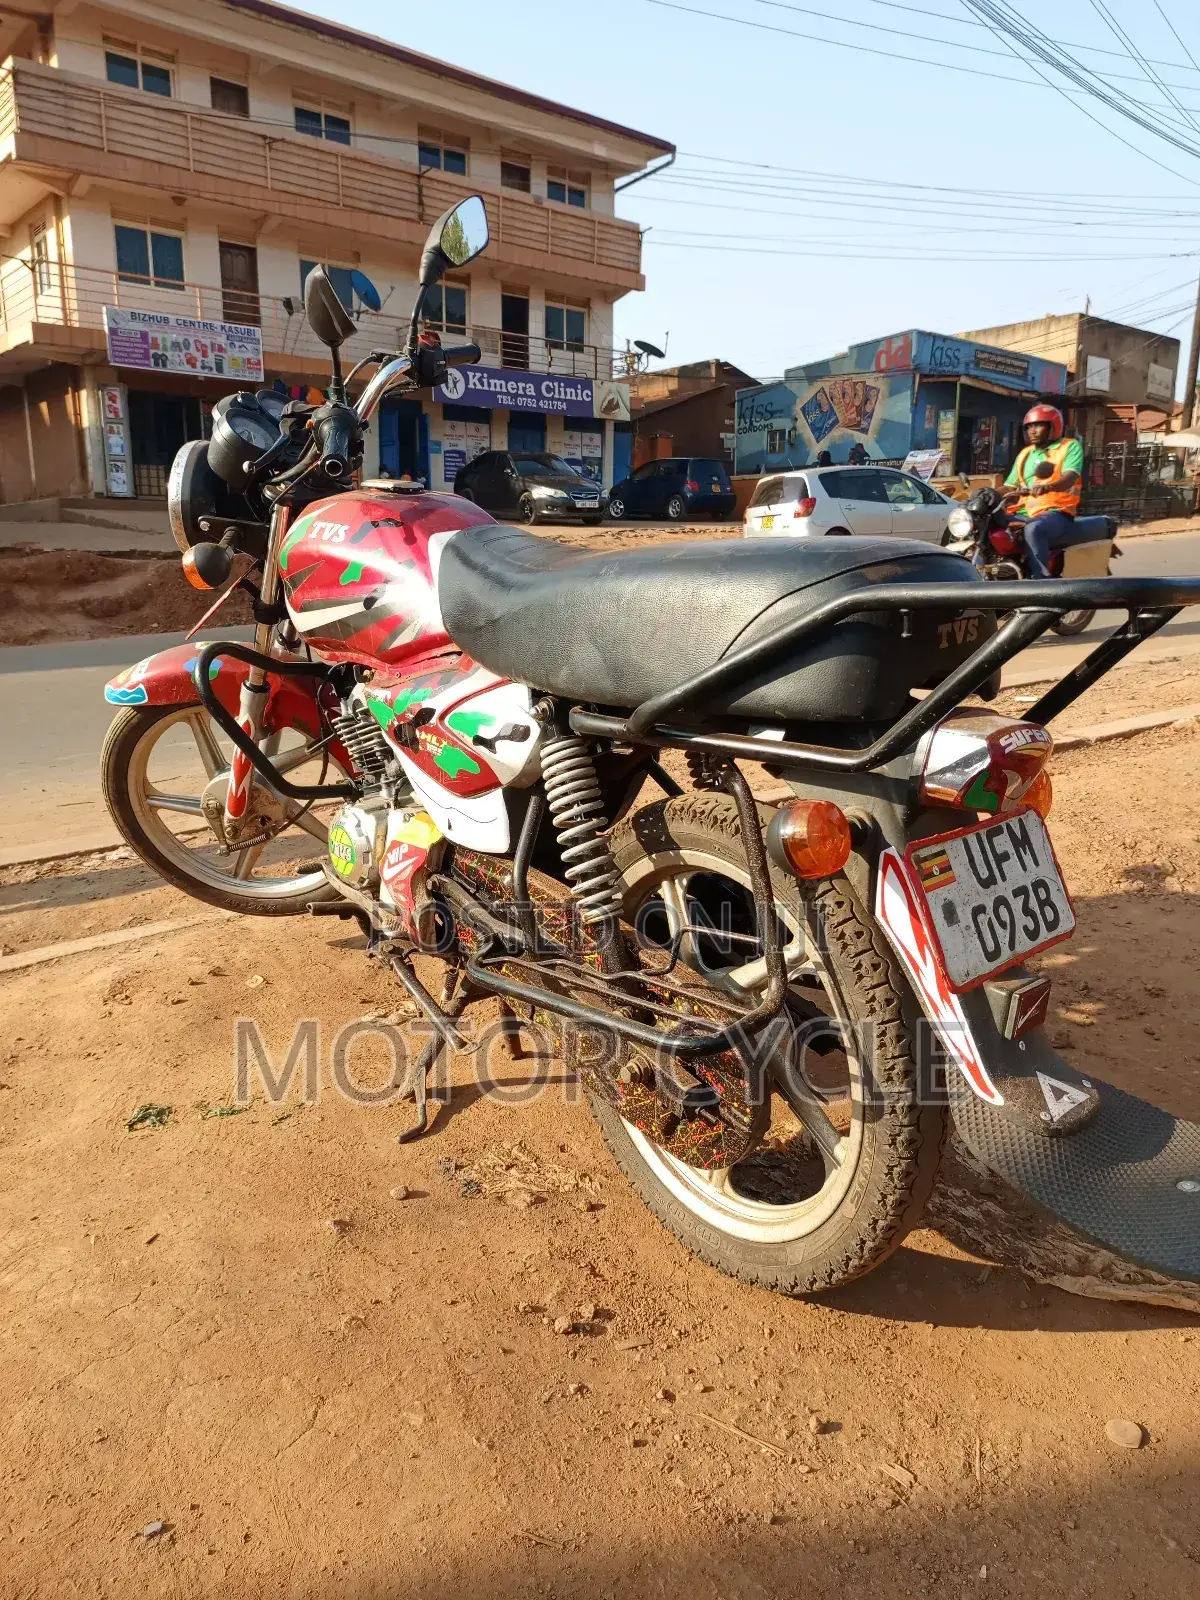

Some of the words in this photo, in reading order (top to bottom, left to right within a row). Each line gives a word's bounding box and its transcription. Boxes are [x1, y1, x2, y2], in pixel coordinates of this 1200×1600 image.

[130, 311, 169, 324] BIZHUB
[220, 324, 256, 337] KASUBI
[466, 371, 536, 396] Kimera
[541, 381, 592, 402] Clinic
[496, 394, 516, 405] TEL:
[517, 397, 537, 408] 0752
[539, 400, 567, 410] 421754
[738, 398, 784, 427] kiss
[737, 422, 774, 435] CONDOMS
[308, 521, 349, 543] TVS
[938, 617, 979, 649] TVS
[386, 843, 409, 865] VIP
[962, 817, 1040, 889] UFM
